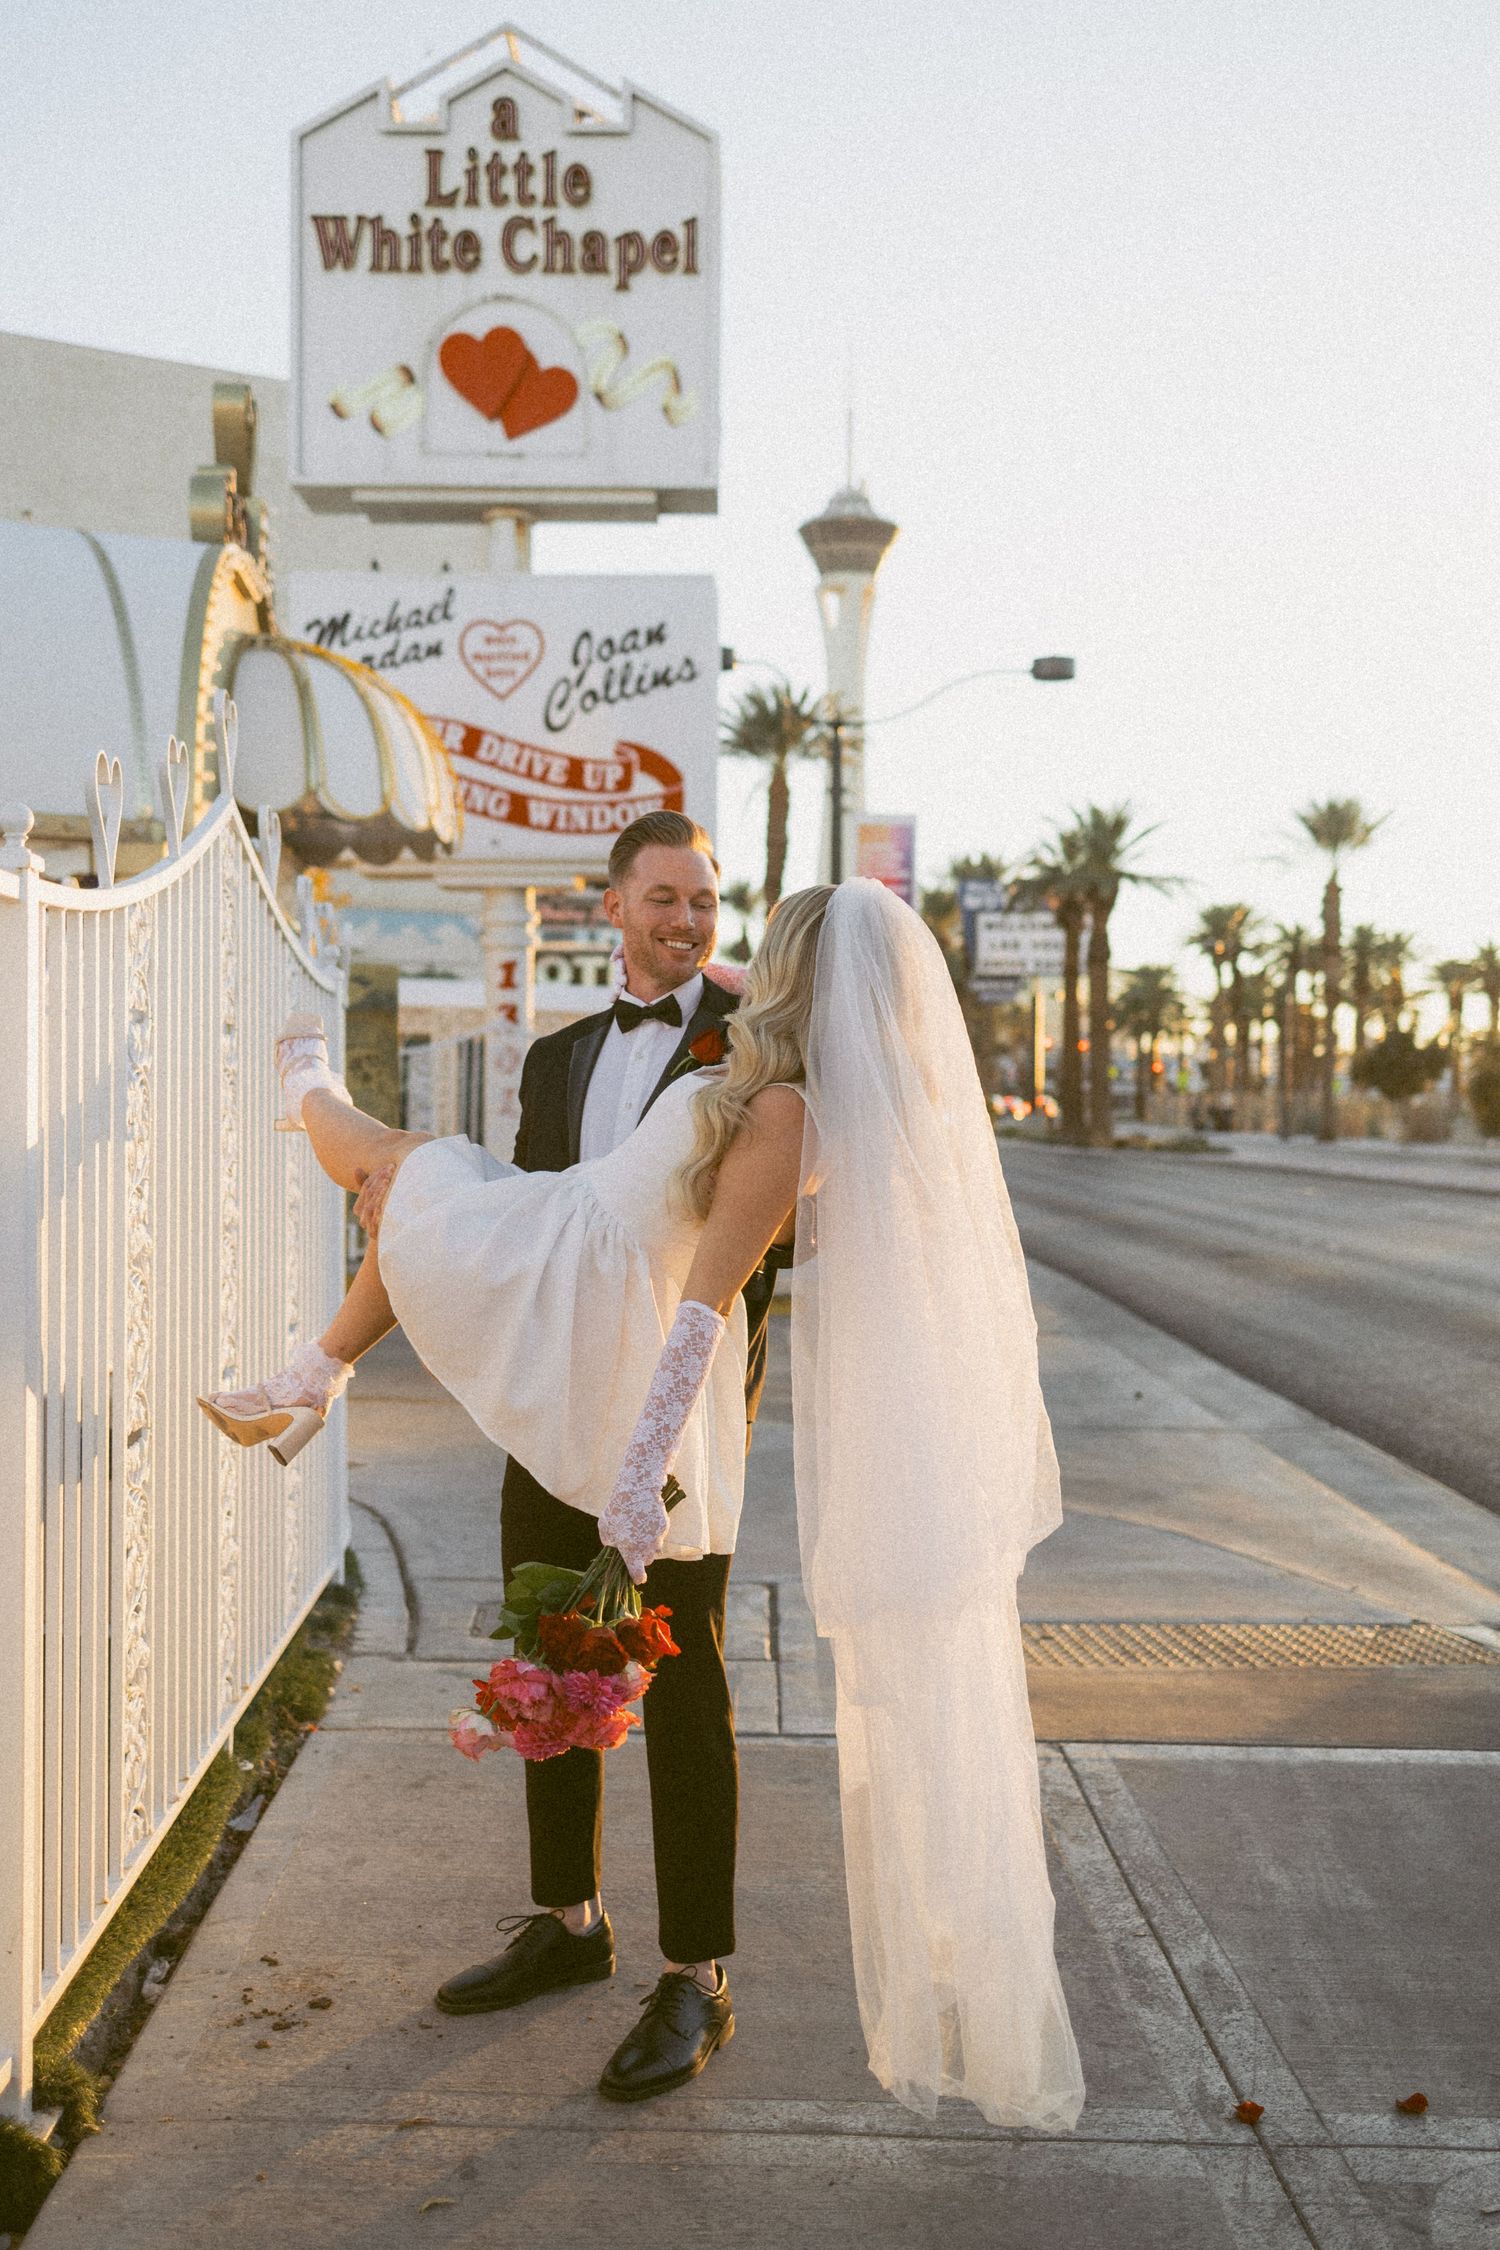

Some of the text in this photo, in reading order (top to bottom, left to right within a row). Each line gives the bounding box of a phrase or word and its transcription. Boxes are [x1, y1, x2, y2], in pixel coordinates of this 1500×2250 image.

[491, 95, 520, 141] a
[424, 147, 593, 207] Little
[311, 213, 700, 292] White Chapel
[305, 587, 455, 647] Michael
[572, 622, 666, 688] Joan
[544, 656, 698, 733] Collins
[480, 731, 571, 786] DRIVE
[583, 760, 625, 793] UP
